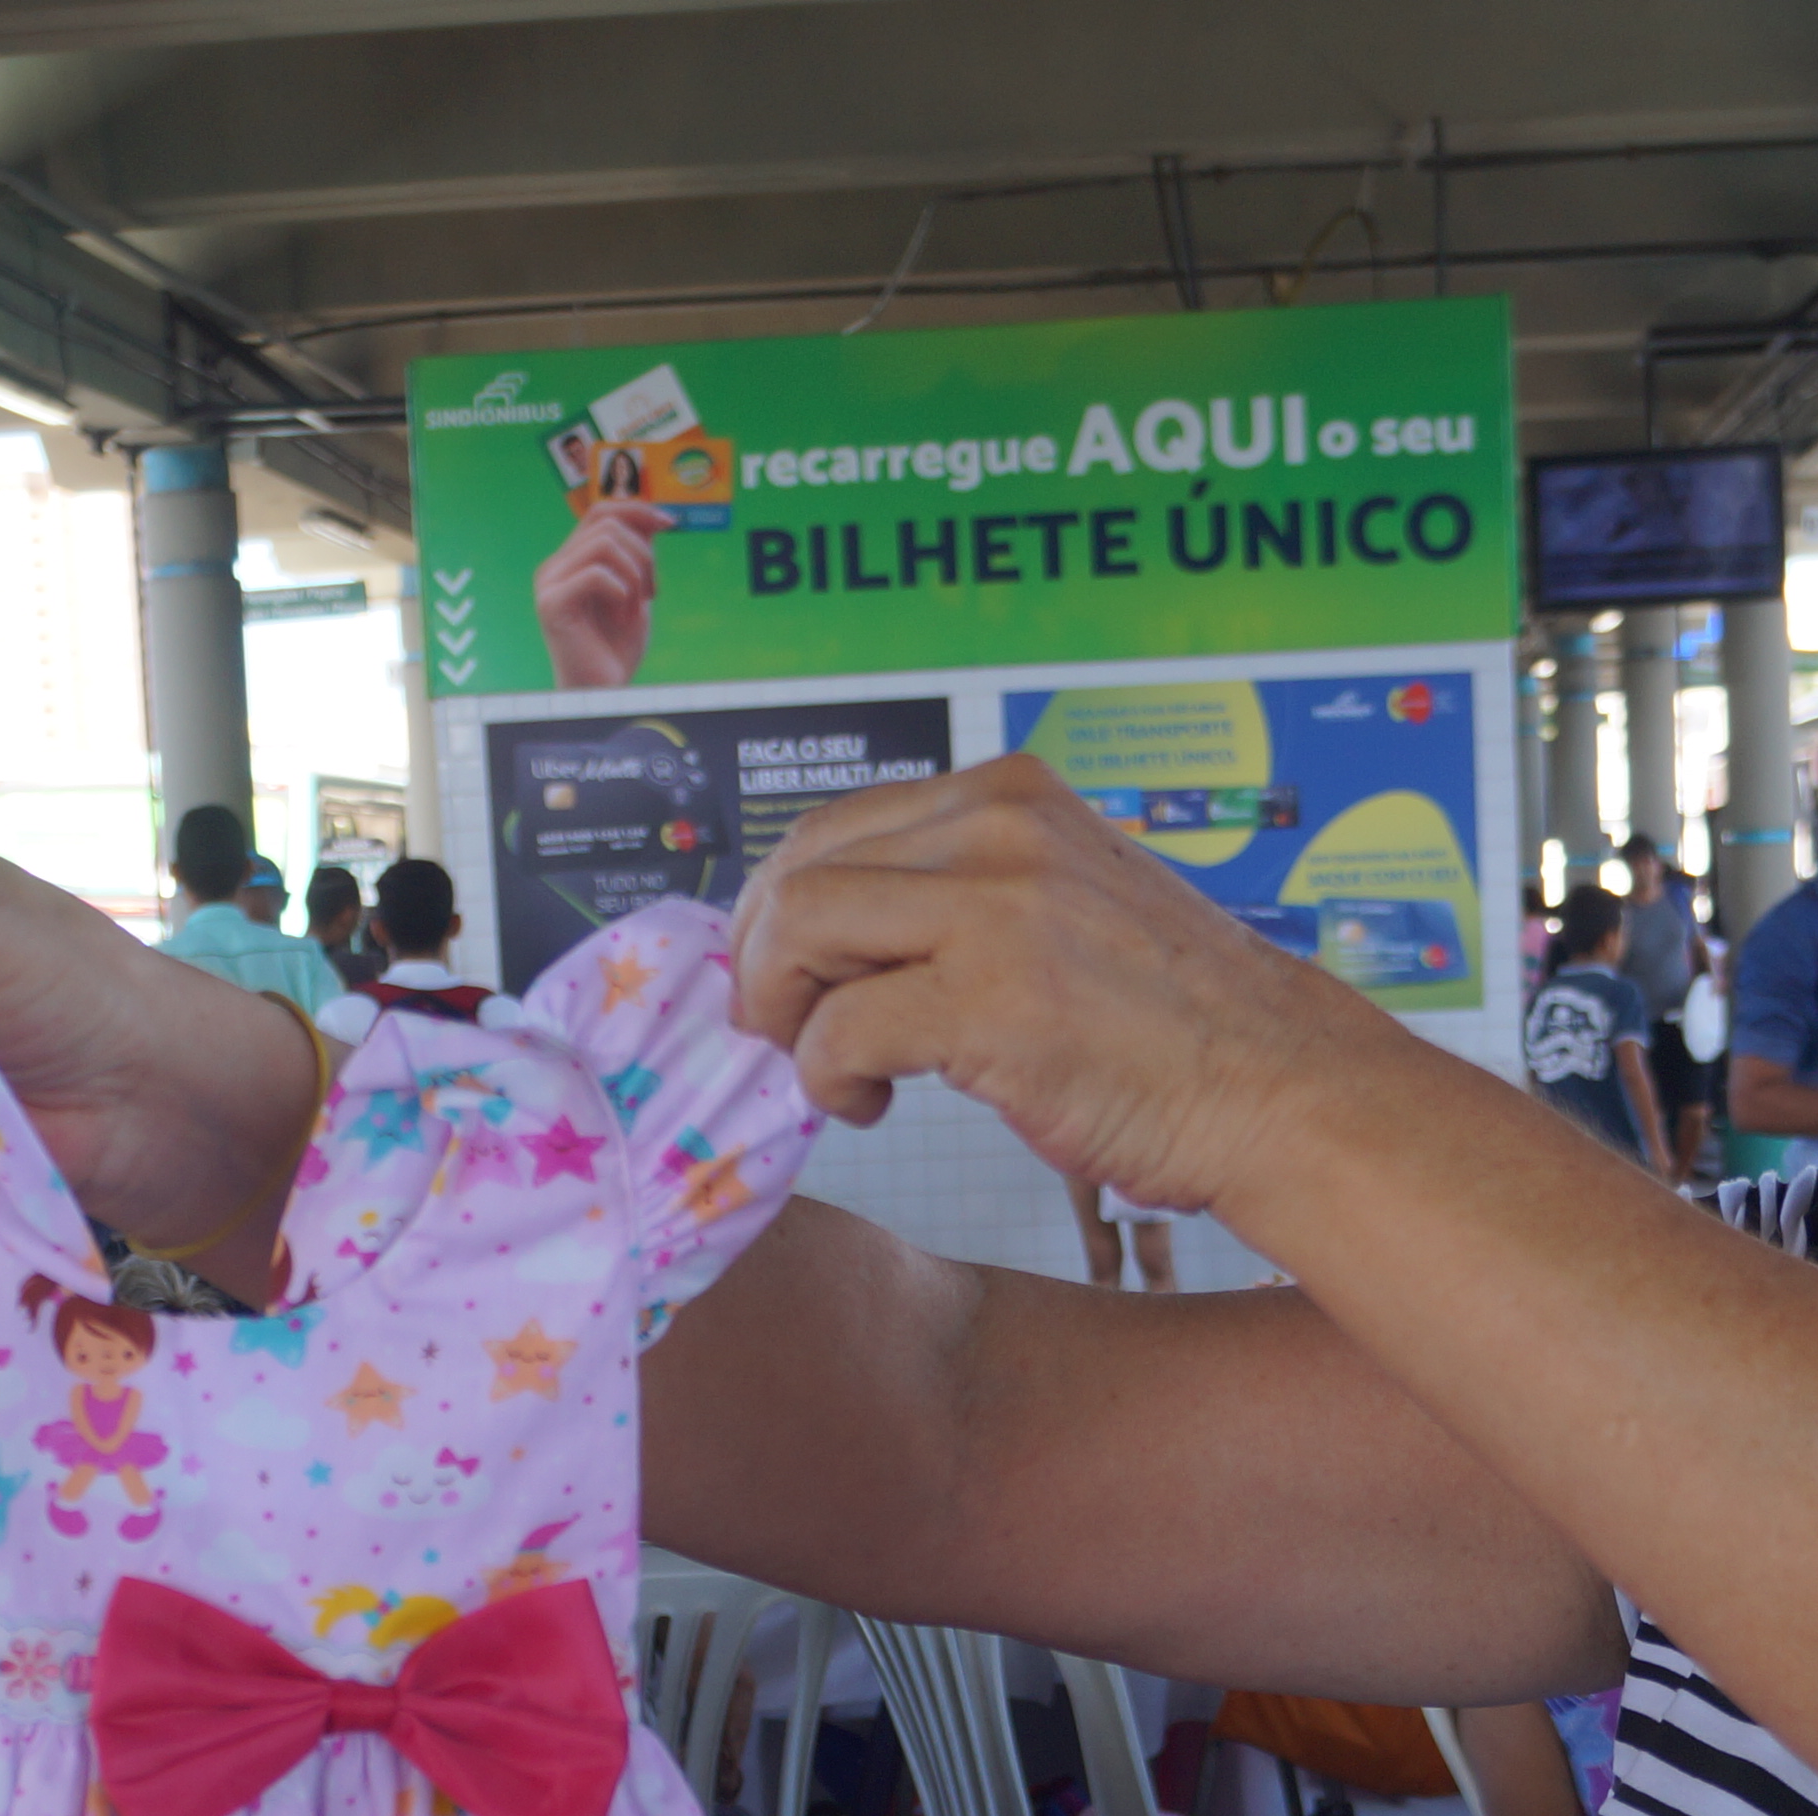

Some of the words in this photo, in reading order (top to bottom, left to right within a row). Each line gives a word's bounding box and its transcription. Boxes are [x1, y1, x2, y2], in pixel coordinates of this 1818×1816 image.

[741, 434, 1057, 492] recarregue
[1067, 394, 1308, 476] AQUI
[1318, 420, 1360, 458] o
[1371, 414, 1476, 456] seu
[746, 507, 1140, 596] BILHETE
[1167, 479, 1473, 574] ÚNICO
[739, 764, 801, 791] LIBER
[803, 761, 874, 788] MULTI
[799, 736, 819, 761] O
